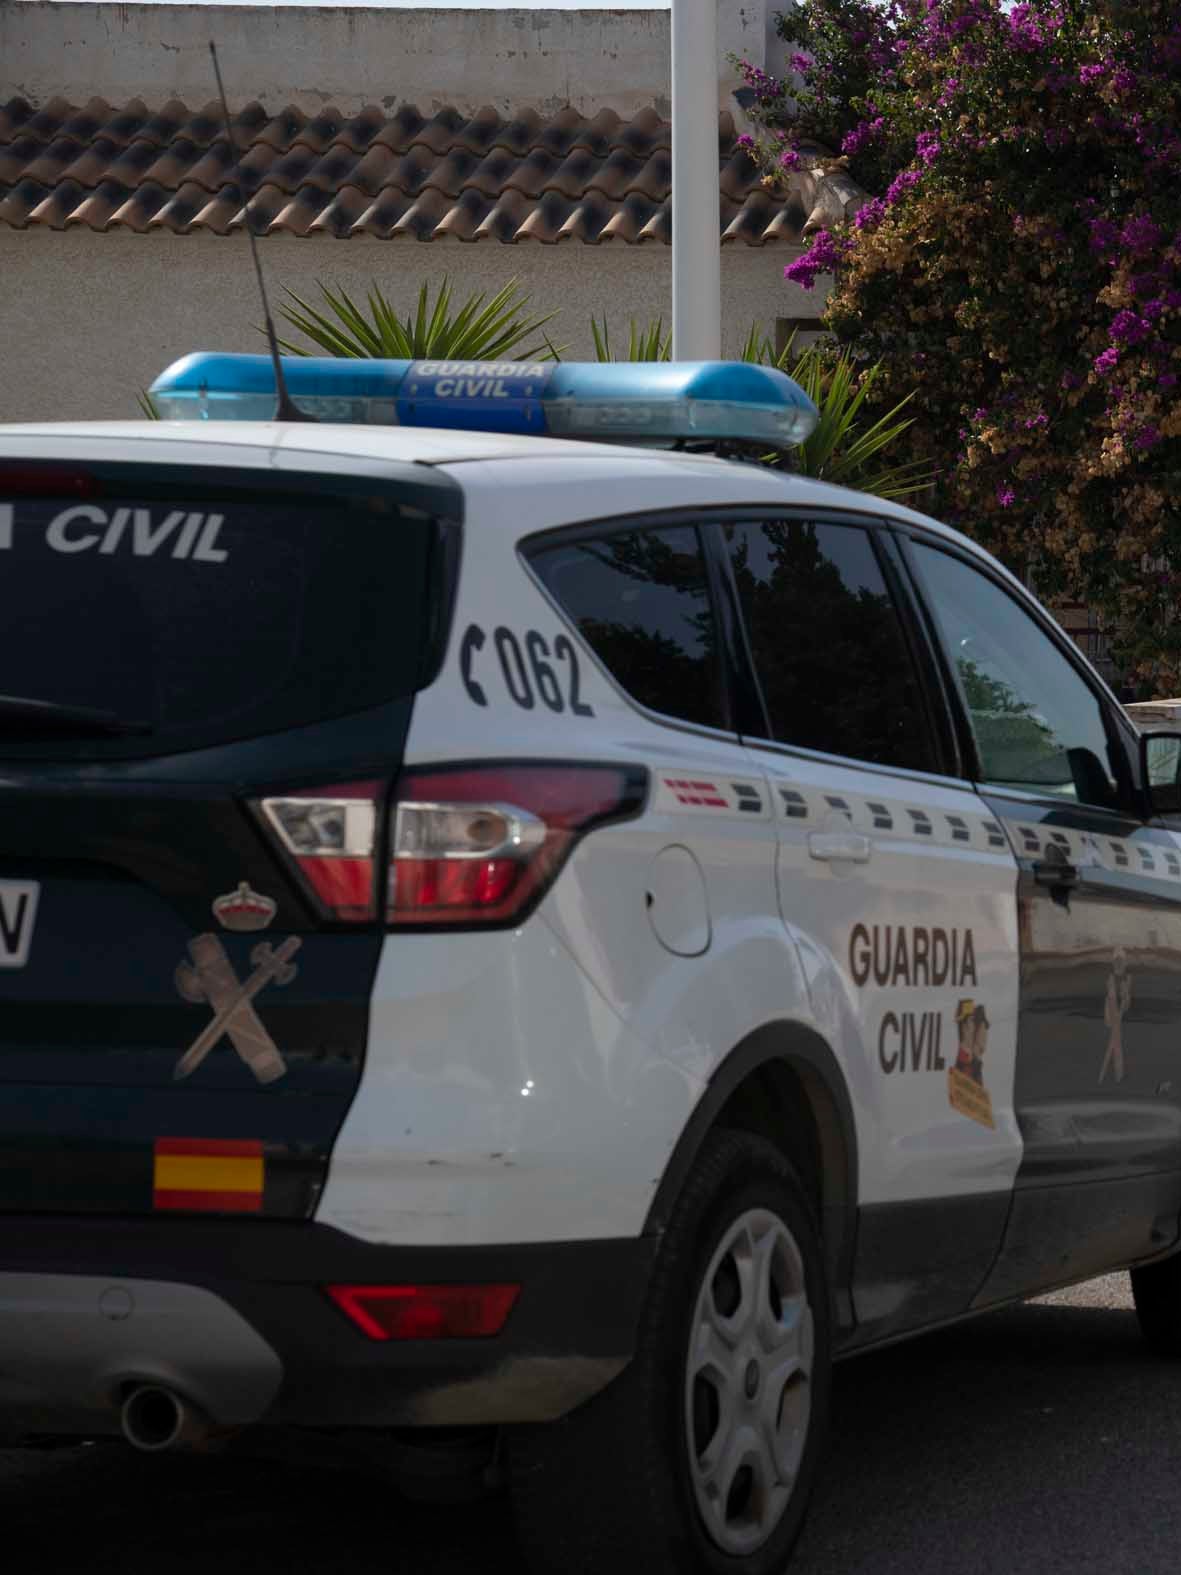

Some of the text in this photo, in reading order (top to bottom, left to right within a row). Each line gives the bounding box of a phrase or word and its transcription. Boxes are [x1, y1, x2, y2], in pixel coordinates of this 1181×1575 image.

[416, 361, 546, 377] GUARDIA
[434, 379, 509, 398] CIVIL
[46, 504, 229, 563] CIVIL
[496, 626, 595, 718] 062
[850, 922, 977, 988] GUARDIA
[878, 1011, 945, 1075] CIVIL
